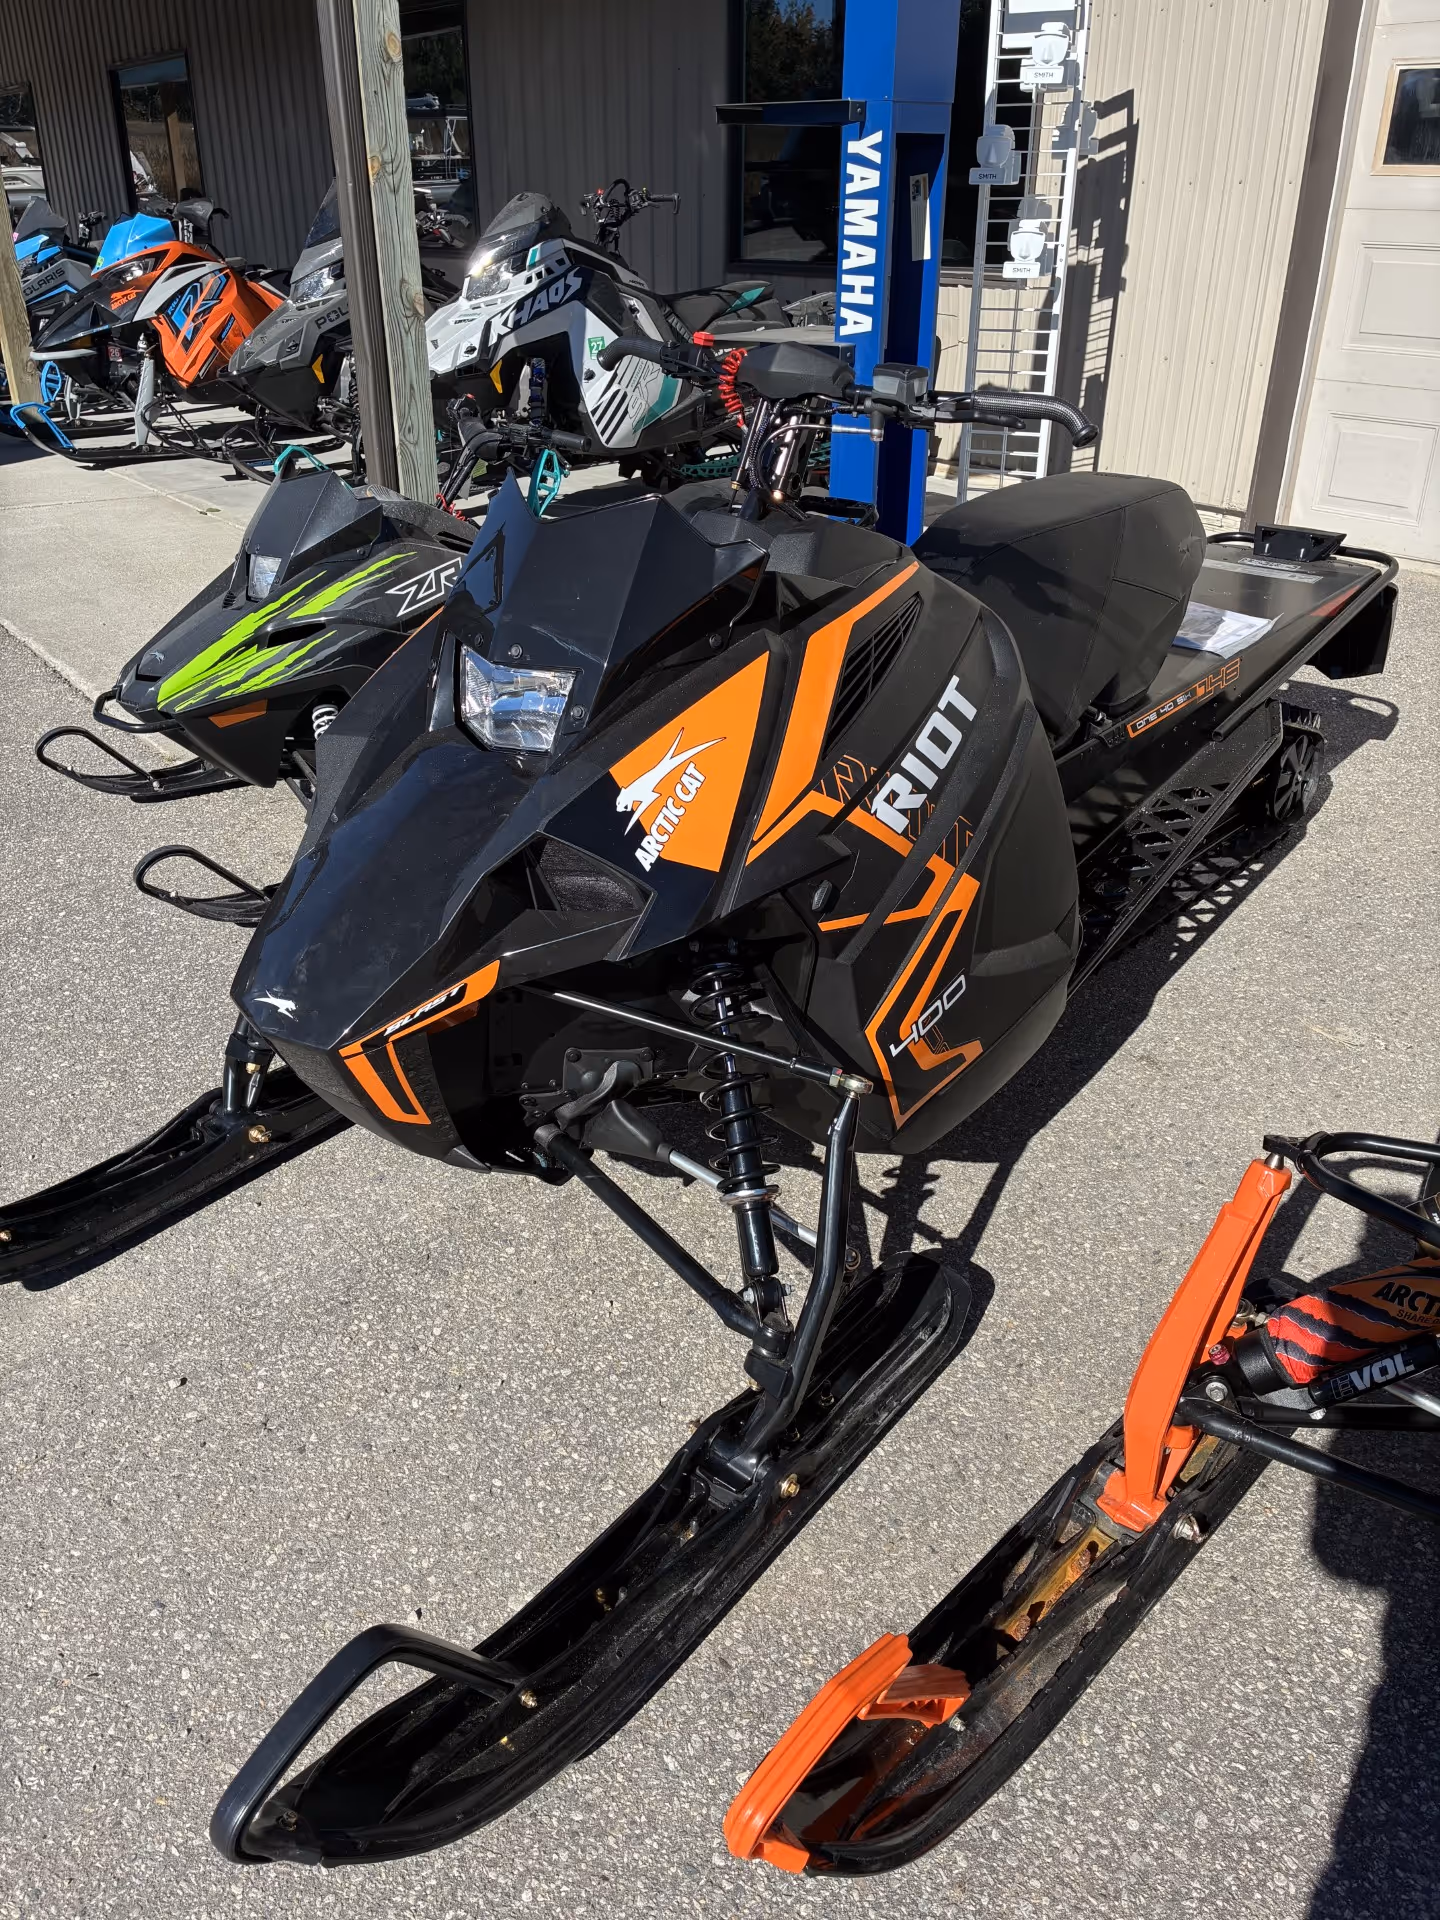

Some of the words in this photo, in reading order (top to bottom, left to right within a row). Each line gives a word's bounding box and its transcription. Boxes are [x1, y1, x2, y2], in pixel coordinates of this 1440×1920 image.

[1033, 71, 1054, 79] SMITH
[839, 130, 883, 336] YAMAHA
[23, 267, 66, 296] OLARIS
[314, 303, 349, 329] POL
[488, 268, 583, 347] KHAOS
[110, 348, 120, 357] 26
[591, 341, 603, 354] 27
[1136, 712, 1158, 730] ONE
[1160, 702, 1175, 714] 40
[1176, 691, 1192, 706] SIX
[871, 674, 978, 834] RIOT
[635, 796, 686, 872] ARCTIC
[675, 761, 706, 803] CAT
[383, 983, 465, 1033] BLAST
[889, 974, 966, 1057] 400
[1371, 1280, 1440, 1318] ARCT
[1396, 1309, 1432, 1324] SHARE
[1330, 1352, 1416, 1400] EVOL
